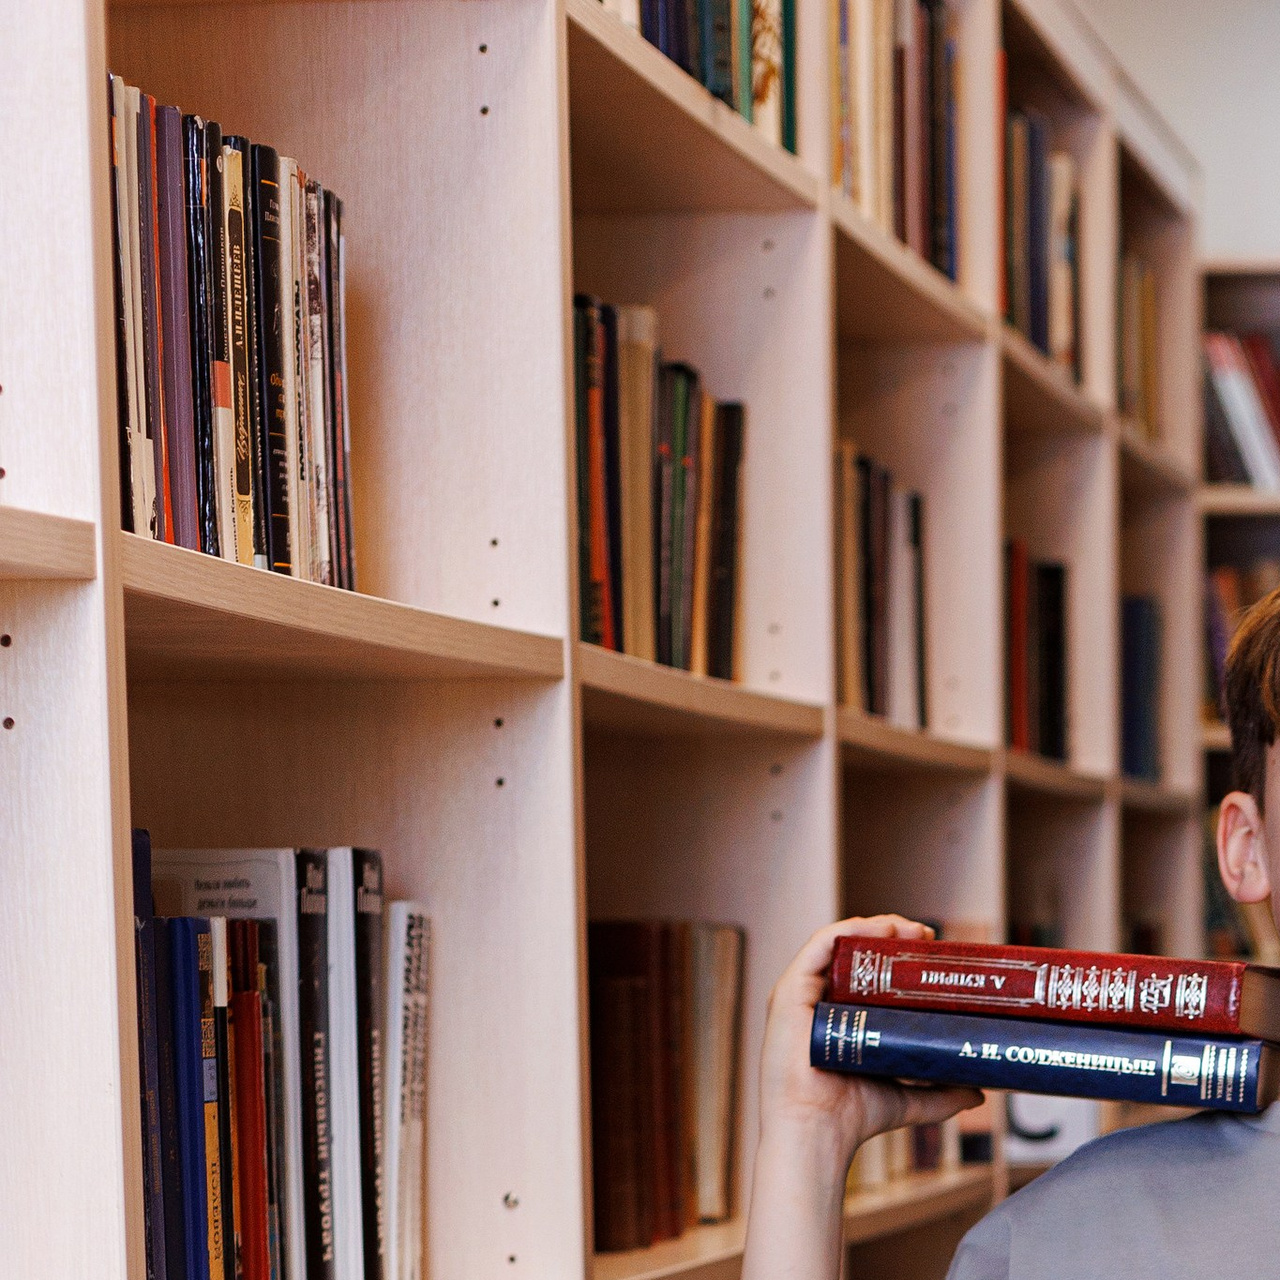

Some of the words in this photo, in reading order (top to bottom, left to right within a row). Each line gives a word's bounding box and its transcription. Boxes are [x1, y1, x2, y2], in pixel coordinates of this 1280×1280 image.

[920, 969, 987, 989] КУПРИН
[958, 1042, 979, 1058] А.
[980, 1045, 1002, 1061] И.
[1004, 1045, 1157, 1076] СОЛЖЕНИЦЫН
